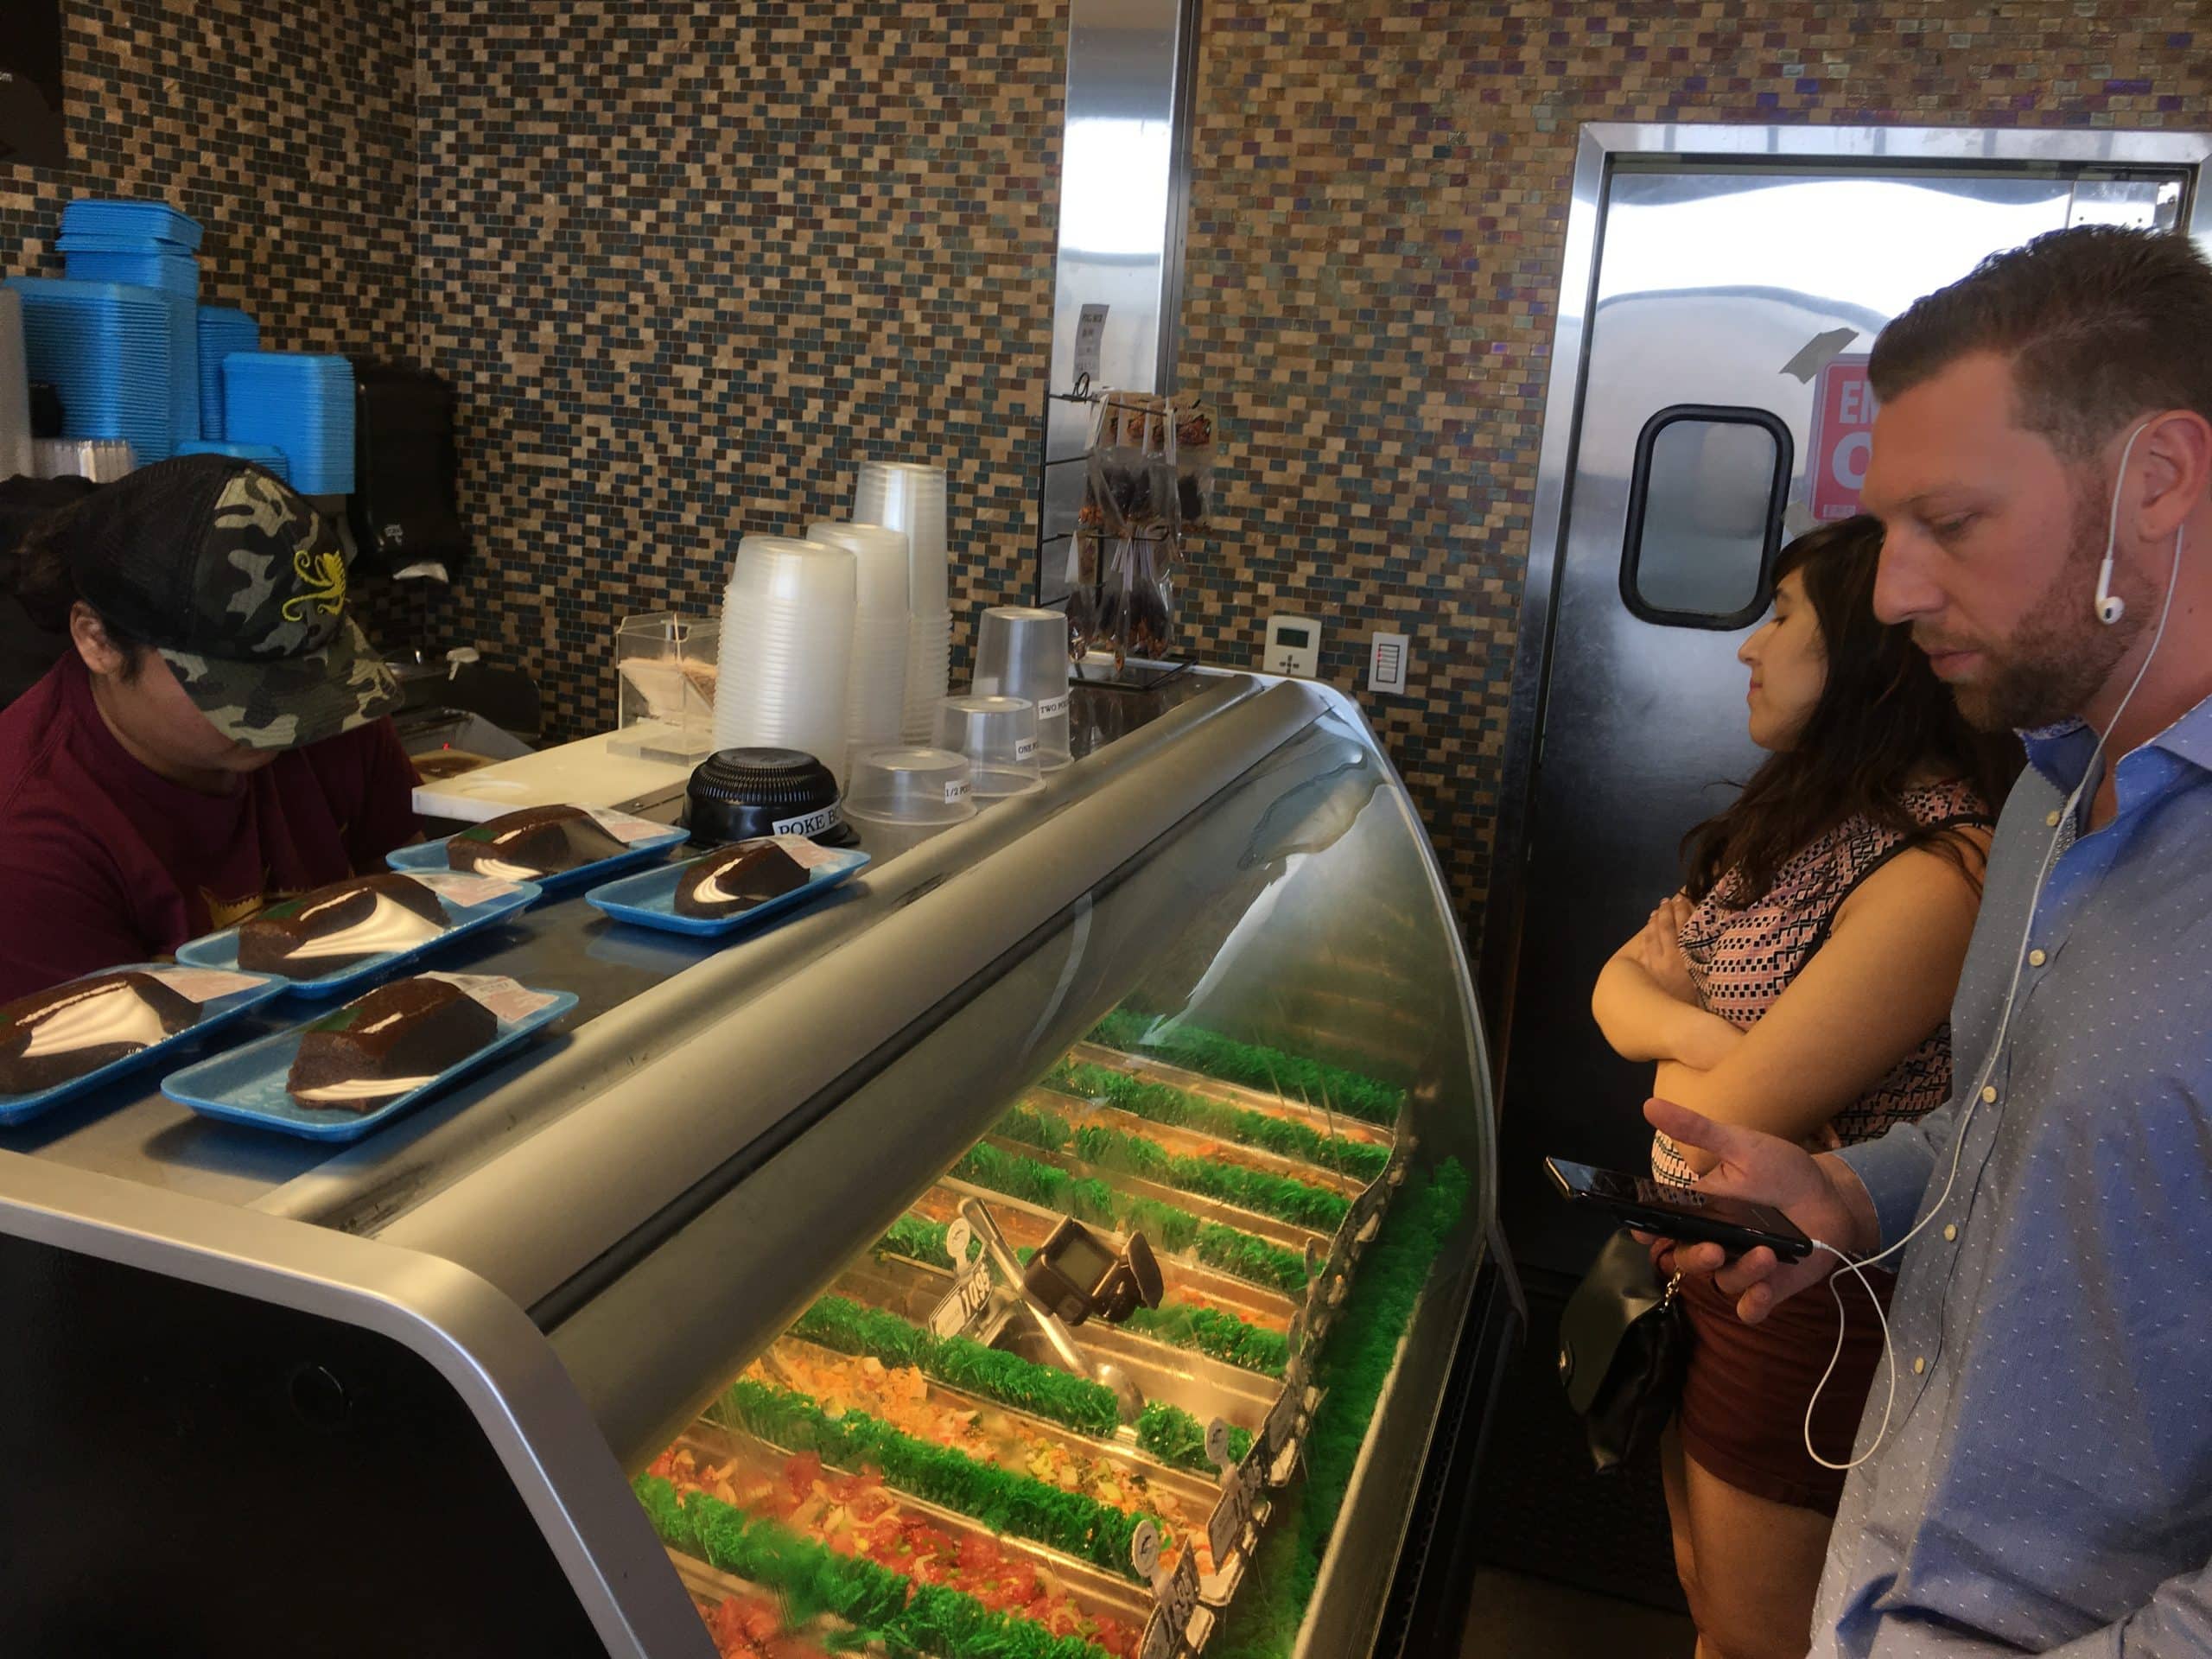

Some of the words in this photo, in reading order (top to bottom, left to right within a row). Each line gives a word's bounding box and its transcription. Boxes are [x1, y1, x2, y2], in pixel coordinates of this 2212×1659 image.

[1039, 702, 1057, 714] TWO
[1018, 743, 1032, 754] ONE
[946, 787, 959, 797] 1/2
[779, 814, 825, 836] POKE
